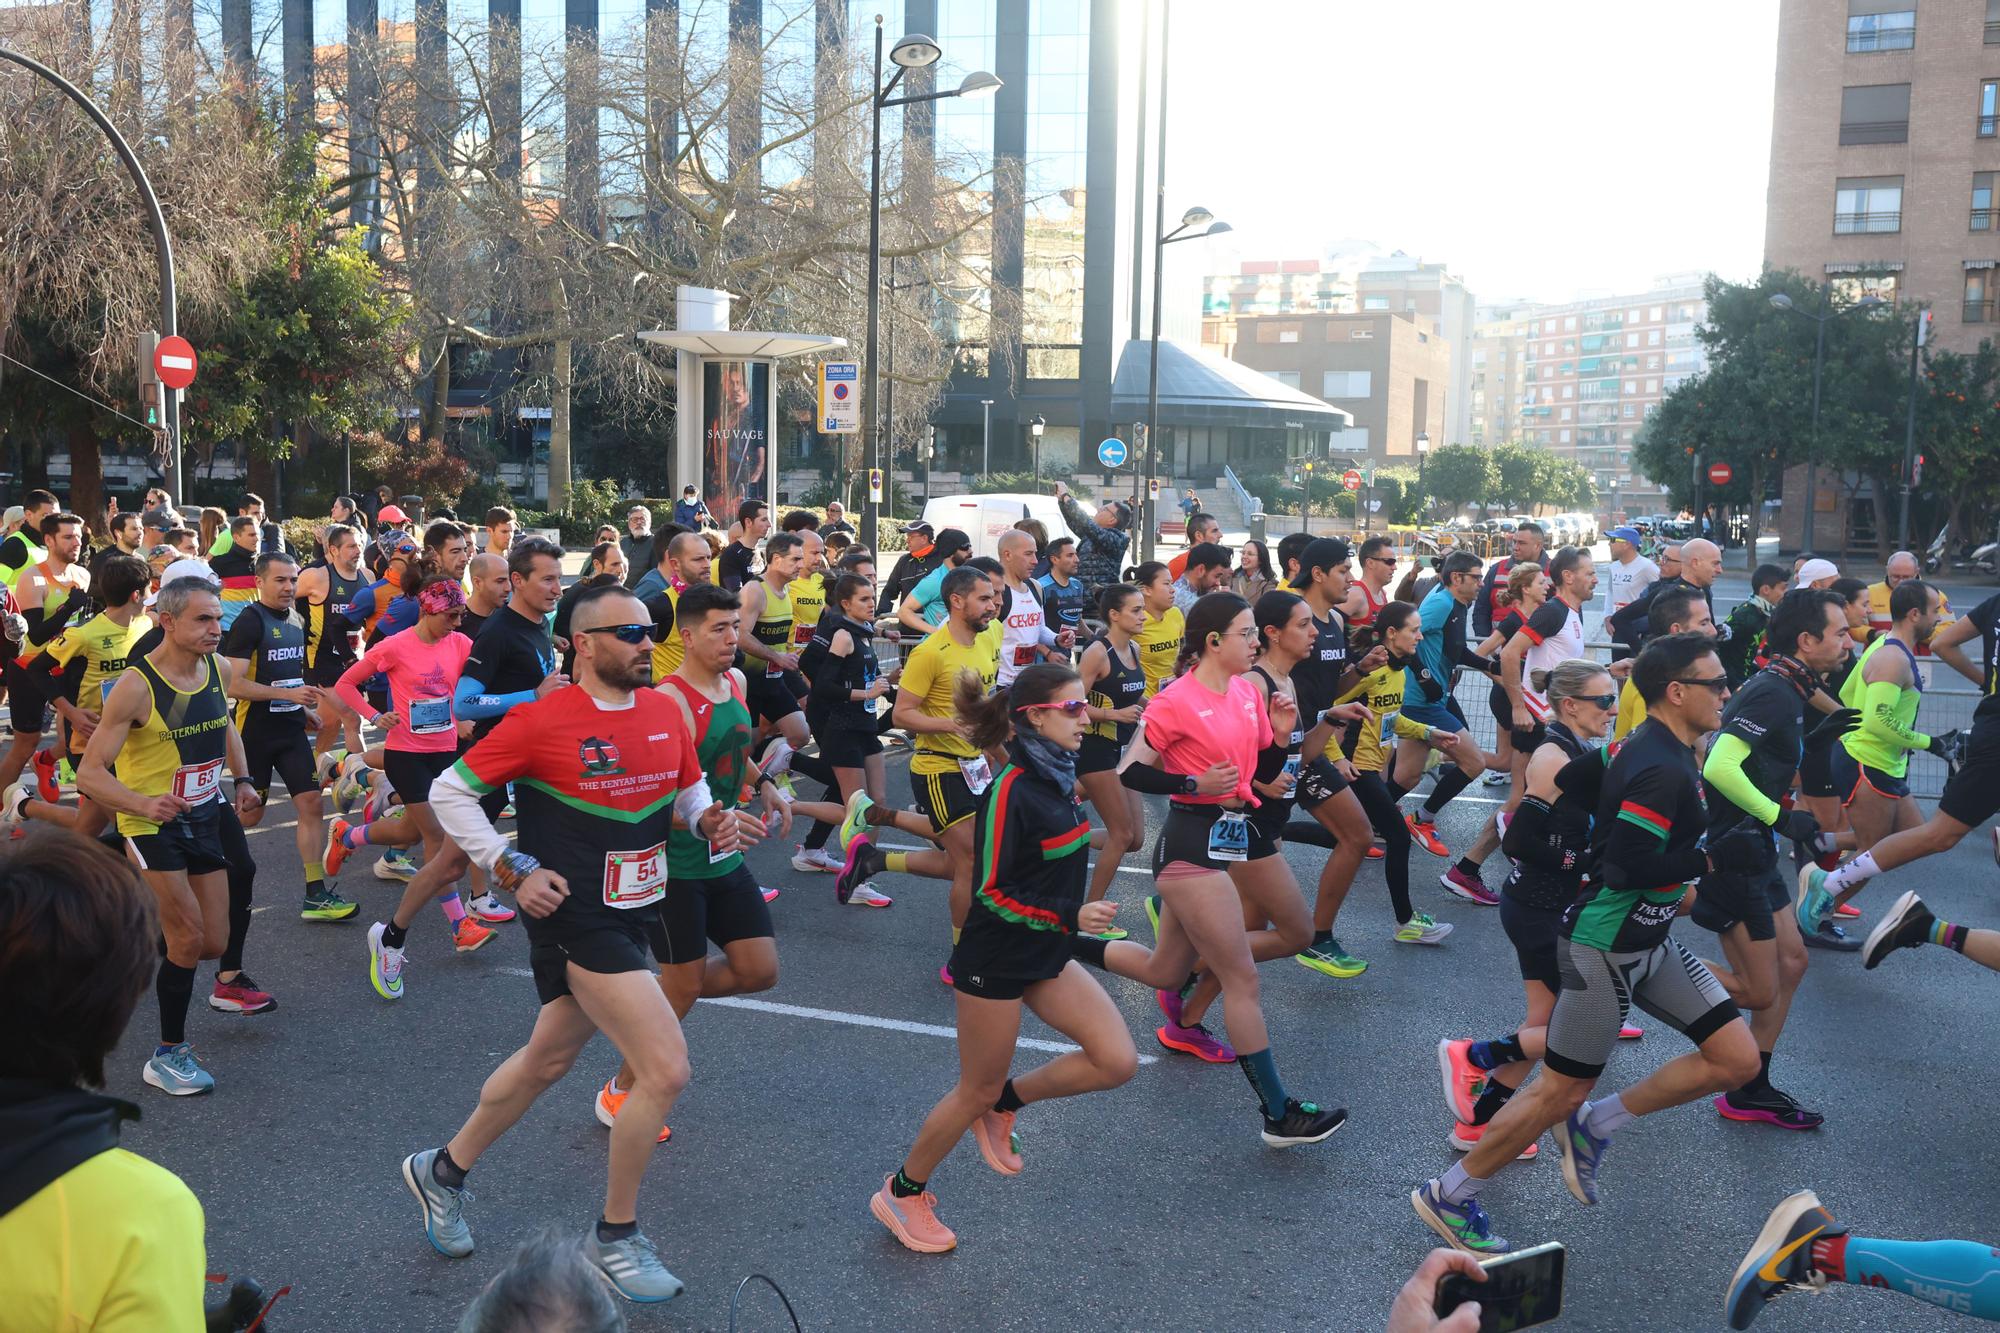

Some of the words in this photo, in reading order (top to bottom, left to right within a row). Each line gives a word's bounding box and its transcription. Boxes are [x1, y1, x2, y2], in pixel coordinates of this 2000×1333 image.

[828, 366, 842, 374] ZONA
[843, 366, 854, 374] ORA
[708, 430, 764, 440] SAUVAGE
[100, 657, 128, 672] RED
[1374, 692, 1402, 707] REDOL
[160, 723, 201, 742] PATERNA
[198, 770, 214, 787] 63
[579, 782, 599, 791] THE
[601, 776, 636, 788] KENYAN
[638, 772, 666, 783] URBAN
[637, 858, 658, 881] 54
